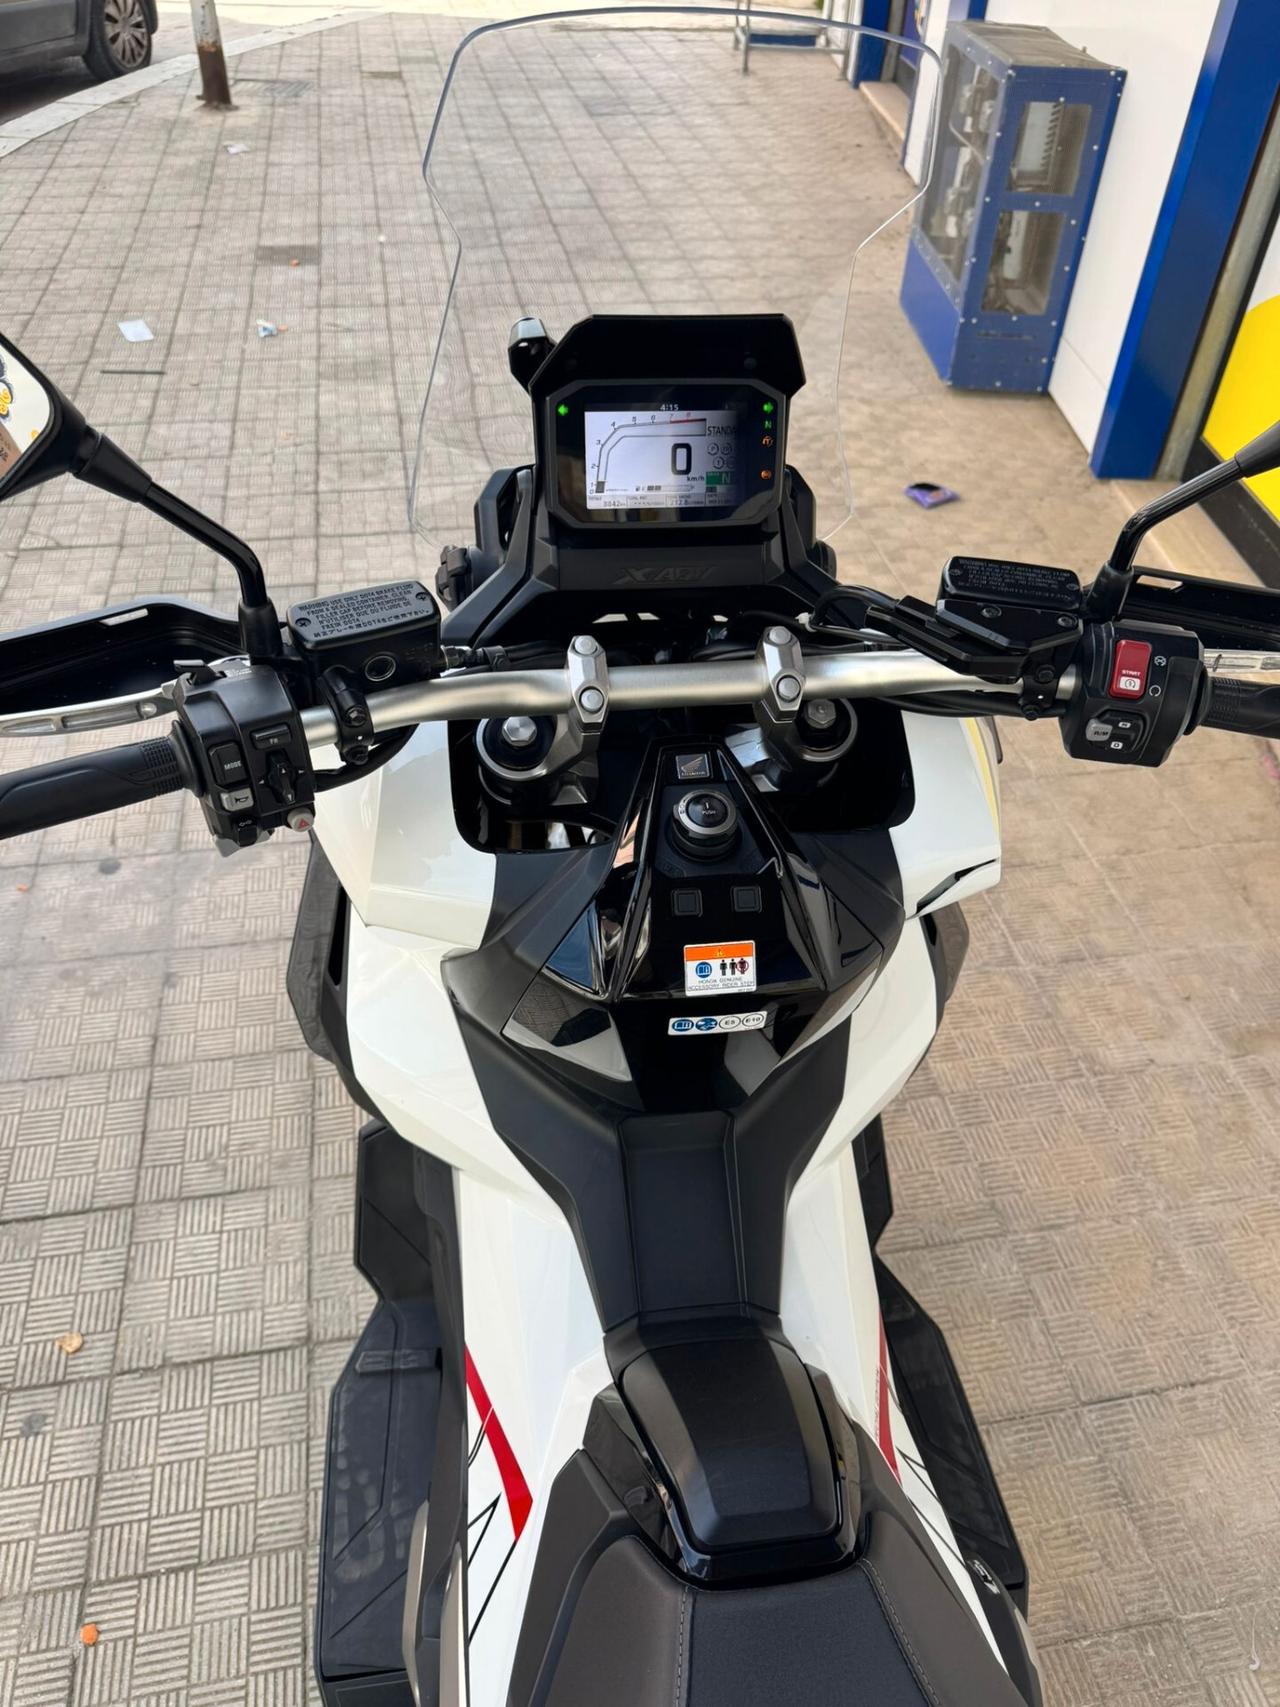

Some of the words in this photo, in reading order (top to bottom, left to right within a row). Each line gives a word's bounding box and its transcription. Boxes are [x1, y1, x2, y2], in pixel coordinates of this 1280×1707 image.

[660, 403, 679, 411] 4:15
[765, 421, 772, 429] N
[671, 443, 692, 475] 0
[298, 600, 330, 611] WARNING
[375, 587, 396, 597] BRAKE
[396, 584, 413, 592] FLUID
[307, 607, 324, 616] FROM
[331, 601, 356, 611] SEALED
[391, 590, 412, 598] CLEAN
[315, 611, 338, 620] FILLER
[340, 608, 352, 616] CAP
[352, 603, 377, 613] BEFORE
[355, 611, 369, 619] QUE
[224, 760, 242, 770] MODE
